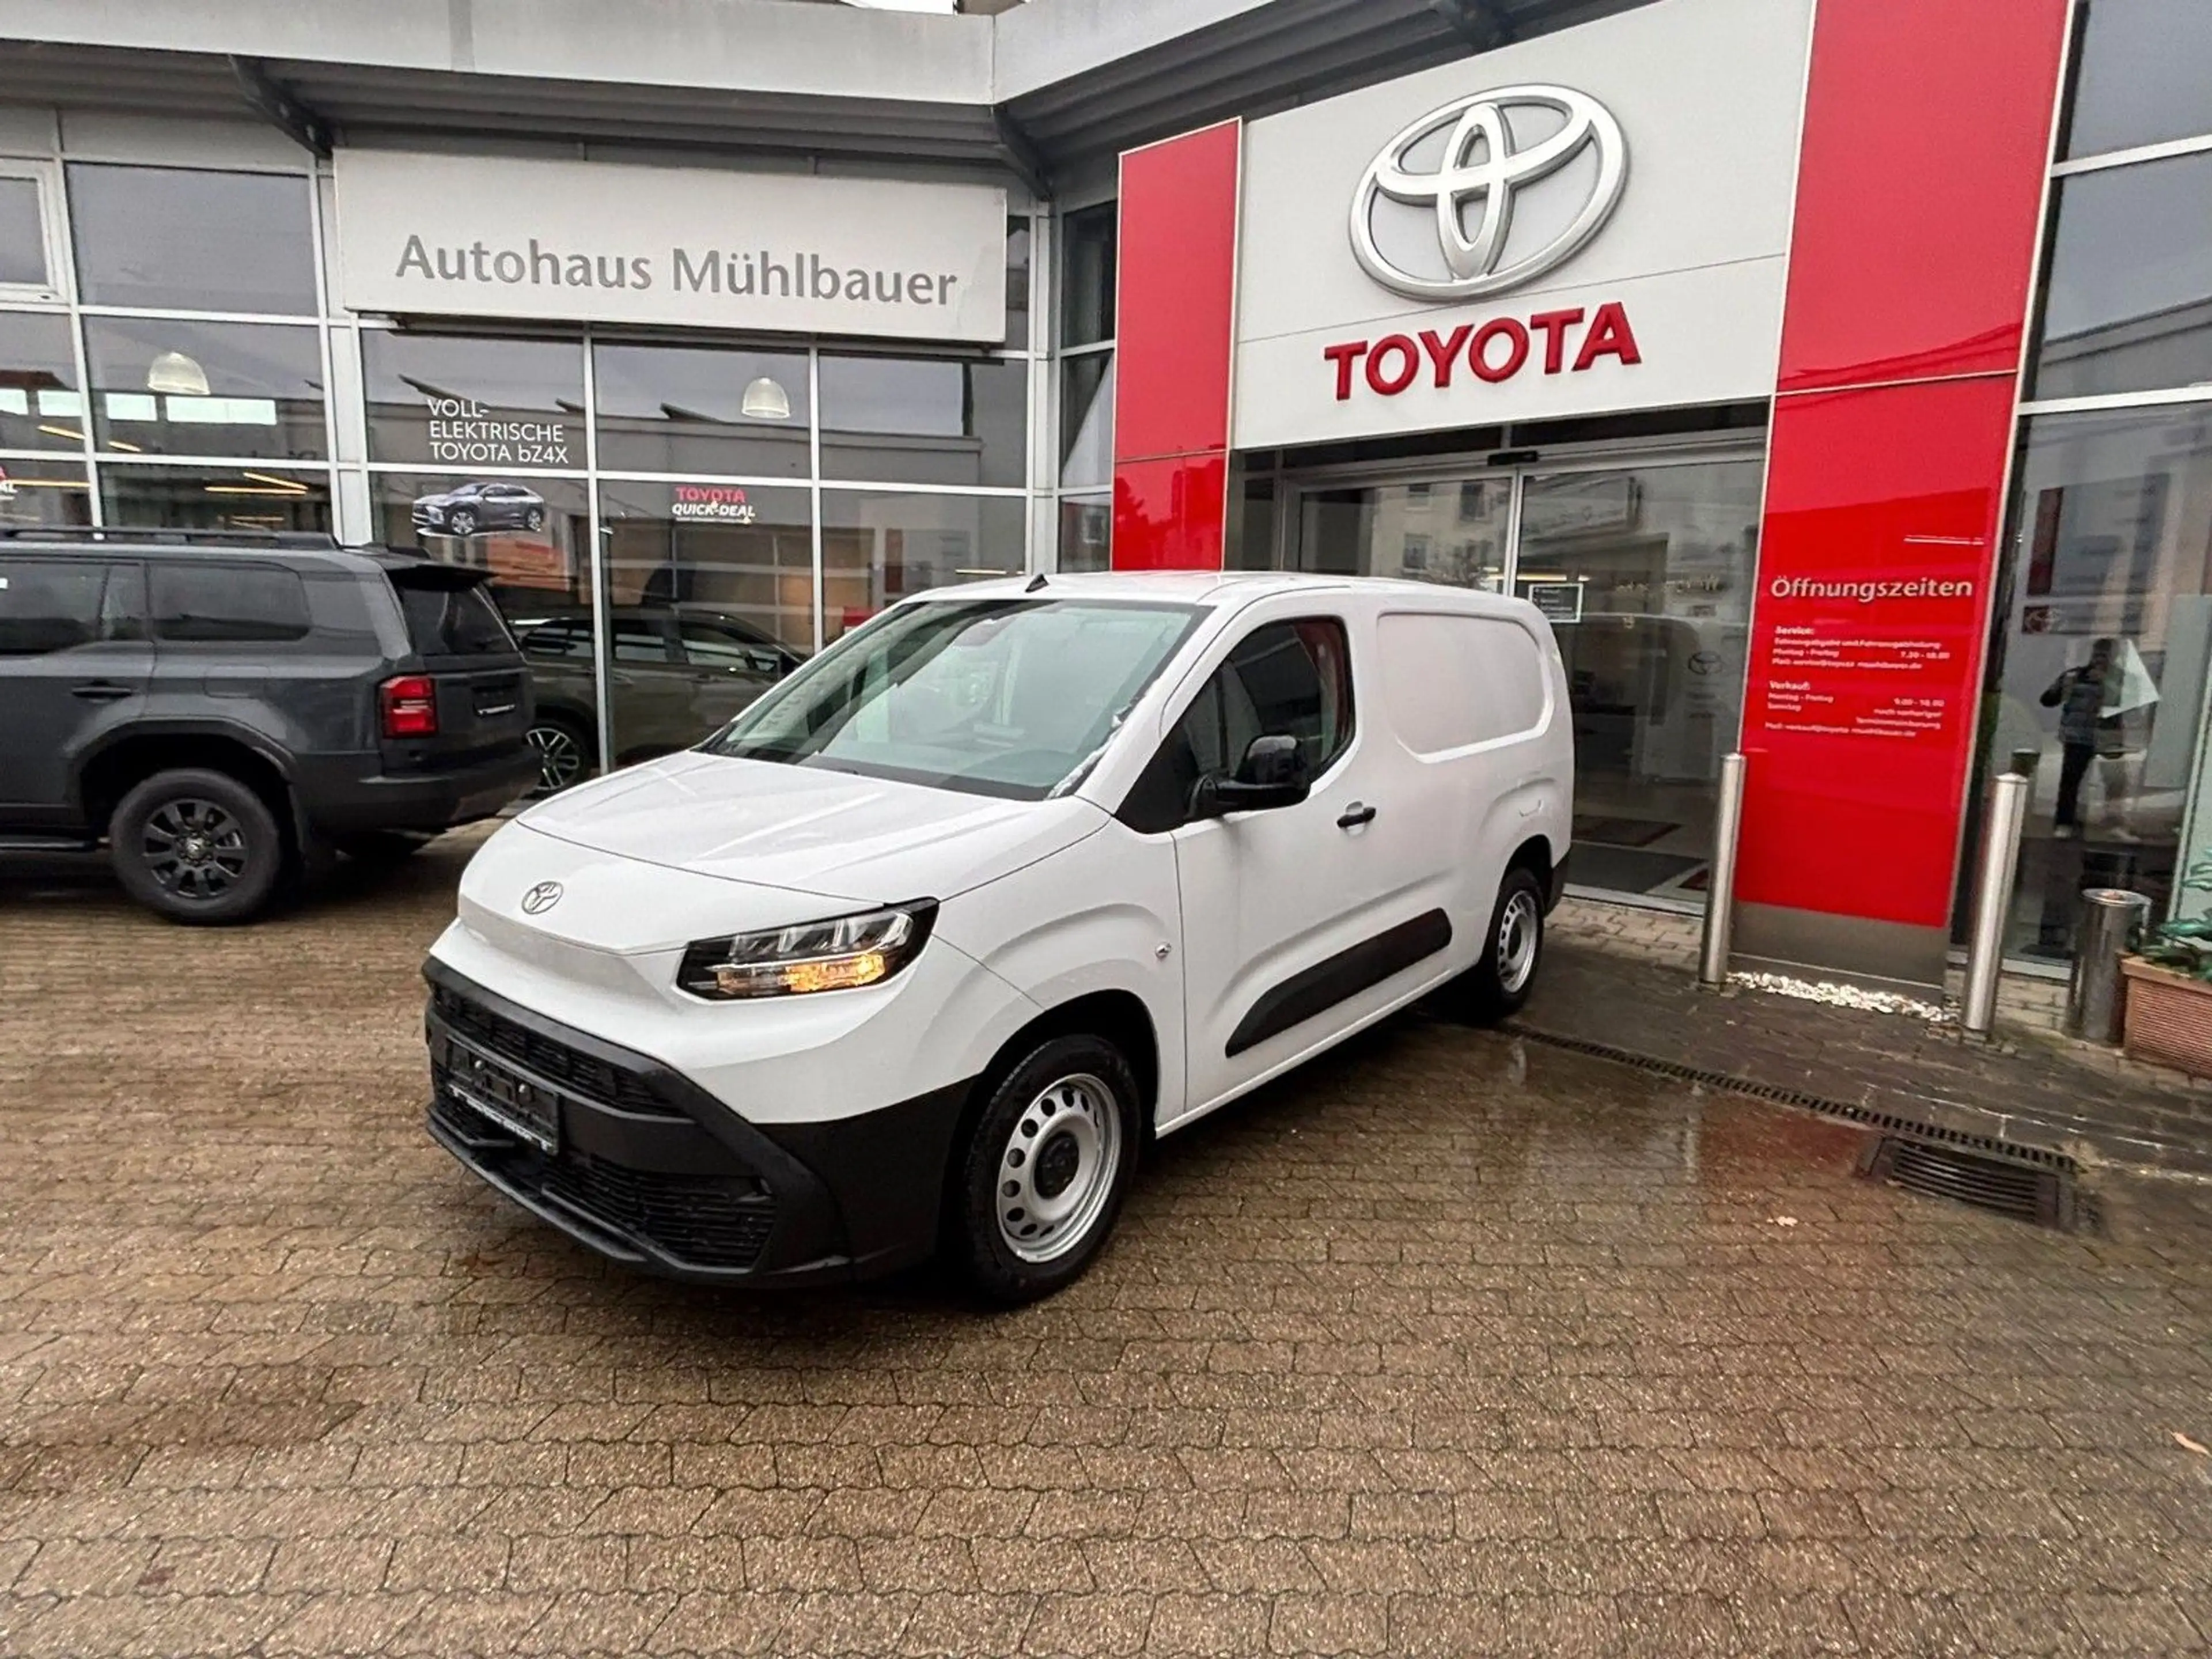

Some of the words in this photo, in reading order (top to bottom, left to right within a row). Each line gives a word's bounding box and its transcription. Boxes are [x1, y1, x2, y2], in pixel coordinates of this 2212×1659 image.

[396, 234, 652, 290] Autohaus
[672, 248, 958, 305] Mühlbauer
[1324, 301, 1642, 401] TOYOTA
[427, 399, 489, 418] VOLL-
[430, 421, 564, 442] ELEKTRISCHE
[430, 442, 512, 461] TOYOTA
[518, 444, 569, 464] bZ4X
[675, 486, 745, 503] TOYOTA
[1771, 575, 1973, 603] Öffnungszeiten
